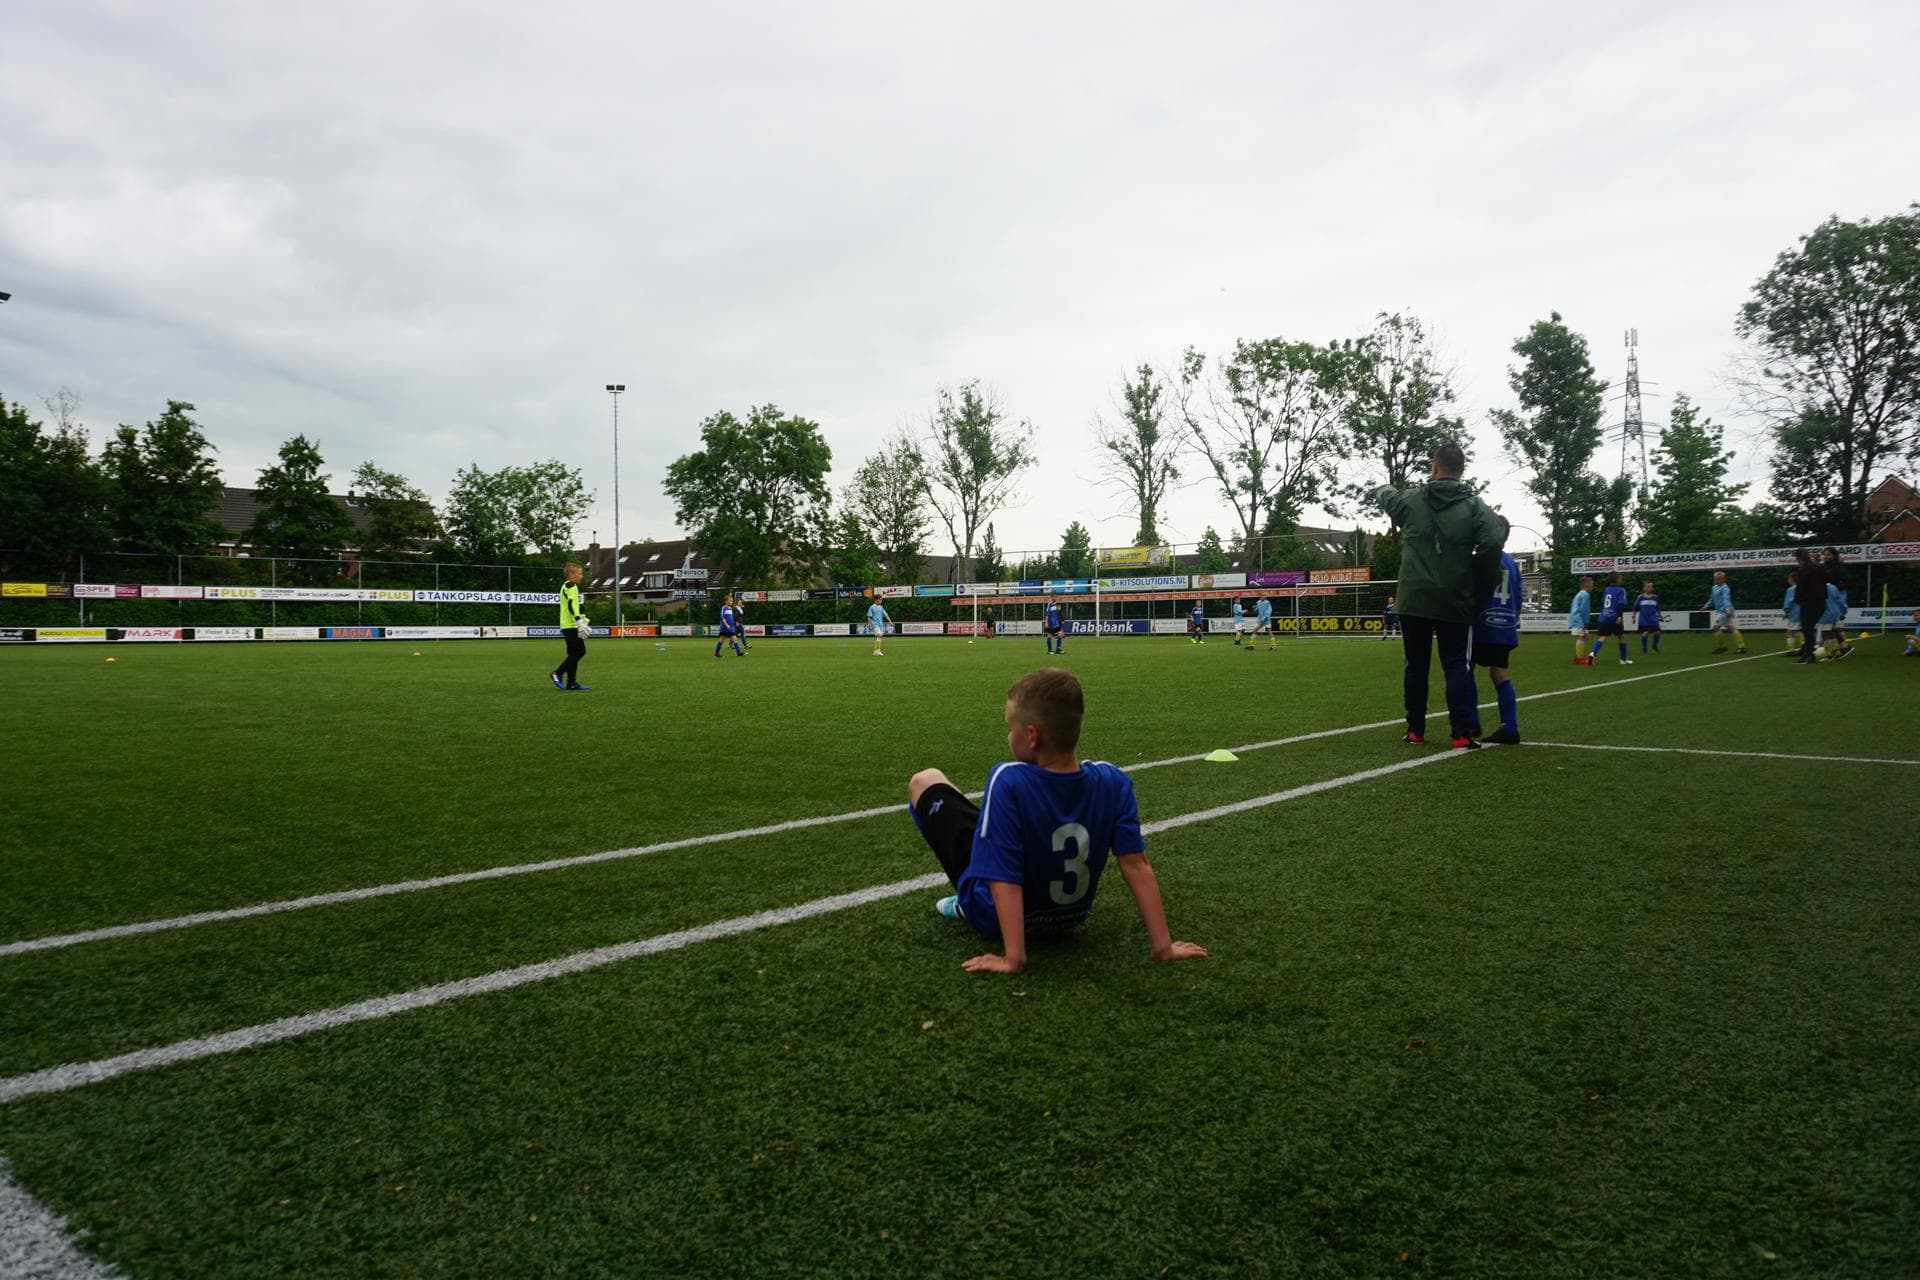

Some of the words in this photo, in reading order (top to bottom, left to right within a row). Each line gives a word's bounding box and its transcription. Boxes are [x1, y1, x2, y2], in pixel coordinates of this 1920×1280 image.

[1886, 545, 1917, 554] GOOS
[1588, 559, 1614, 568] GOOS
[1617, 557, 1630, 566] DE
[1631, 553, 1717, 565] RECLAMEMAKERS
[1718, 552, 1741, 561] VAN
[1743, 551, 1757, 560] DE
[1110, 576, 1187, 587] B-KITSOLUTIONS.NL
[220, 588, 257, 598] PLUS
[1493, 569, 1511, 606] 4
[378, 591, 409, 600] PLUS
[427, 591, 502, 602] TANKOPSLAG
[514, 593, 561, 603] TRANSPO
[1603, 593, 1613, 609] 6
[1071, 620, 1134, 633] Rabobank
[1277, 618, 1307, 631] 100%
[1311, 617, 1339, 631] BOB
[1344, 617, 1361, 630] 0%
[1364, 620, 1382, 631] op
[127, 629, 172, 637] MARK
[332, 628, 372, 638] MAGNA
[1050, 822, 1090, 905] 3
